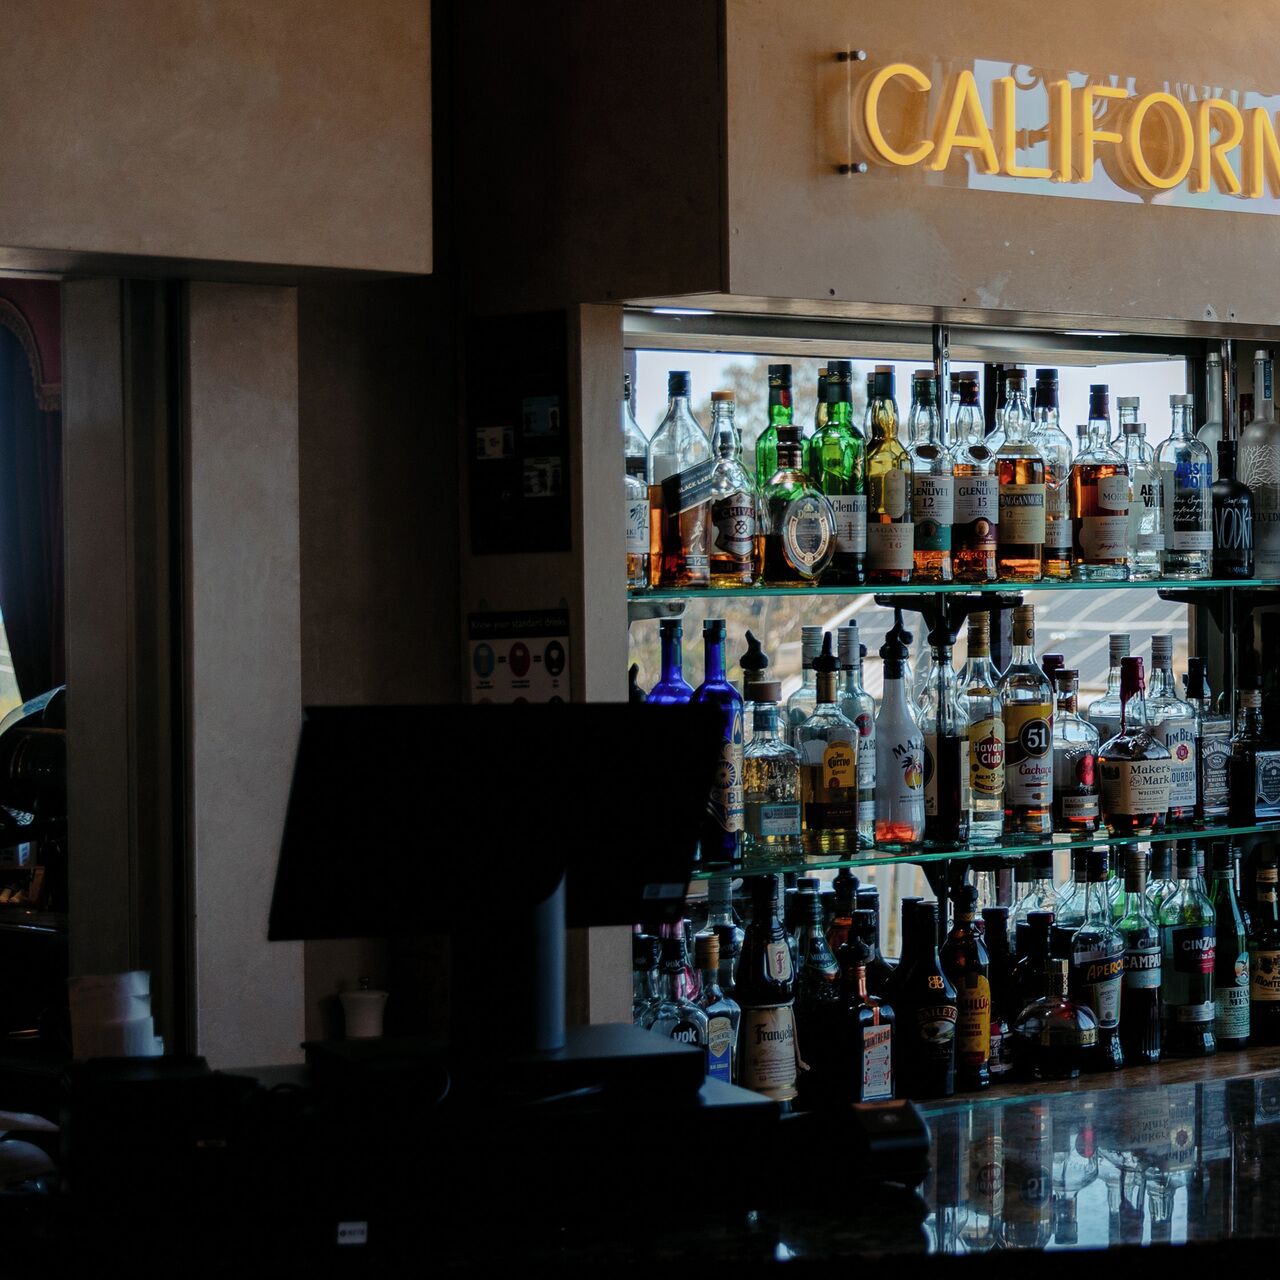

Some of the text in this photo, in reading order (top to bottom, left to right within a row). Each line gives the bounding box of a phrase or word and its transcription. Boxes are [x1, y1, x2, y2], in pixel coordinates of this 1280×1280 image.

[922, 498, 935, 507] 12
[977, 497, 988, 507] 15
[888, 542, 903, 550] 16
[694, 557, 702, 566] 12
[1026, 728, 1048, 748] 51
[1165, 733, 1180, 747] JIM
[828, 756, 851, 768] Cuervo
[981, 752, 1002, 764] Club
[1130, 764, 1171, 775] Maker's
[991, 773, 997, 782] 3
[1142, 775, 1170, 786] Mark
[1171, 771, 1195, 782] OURBON
[1138, 789, 1165, 797] WHISKY
[672, 1028, 697, 1043] vok
